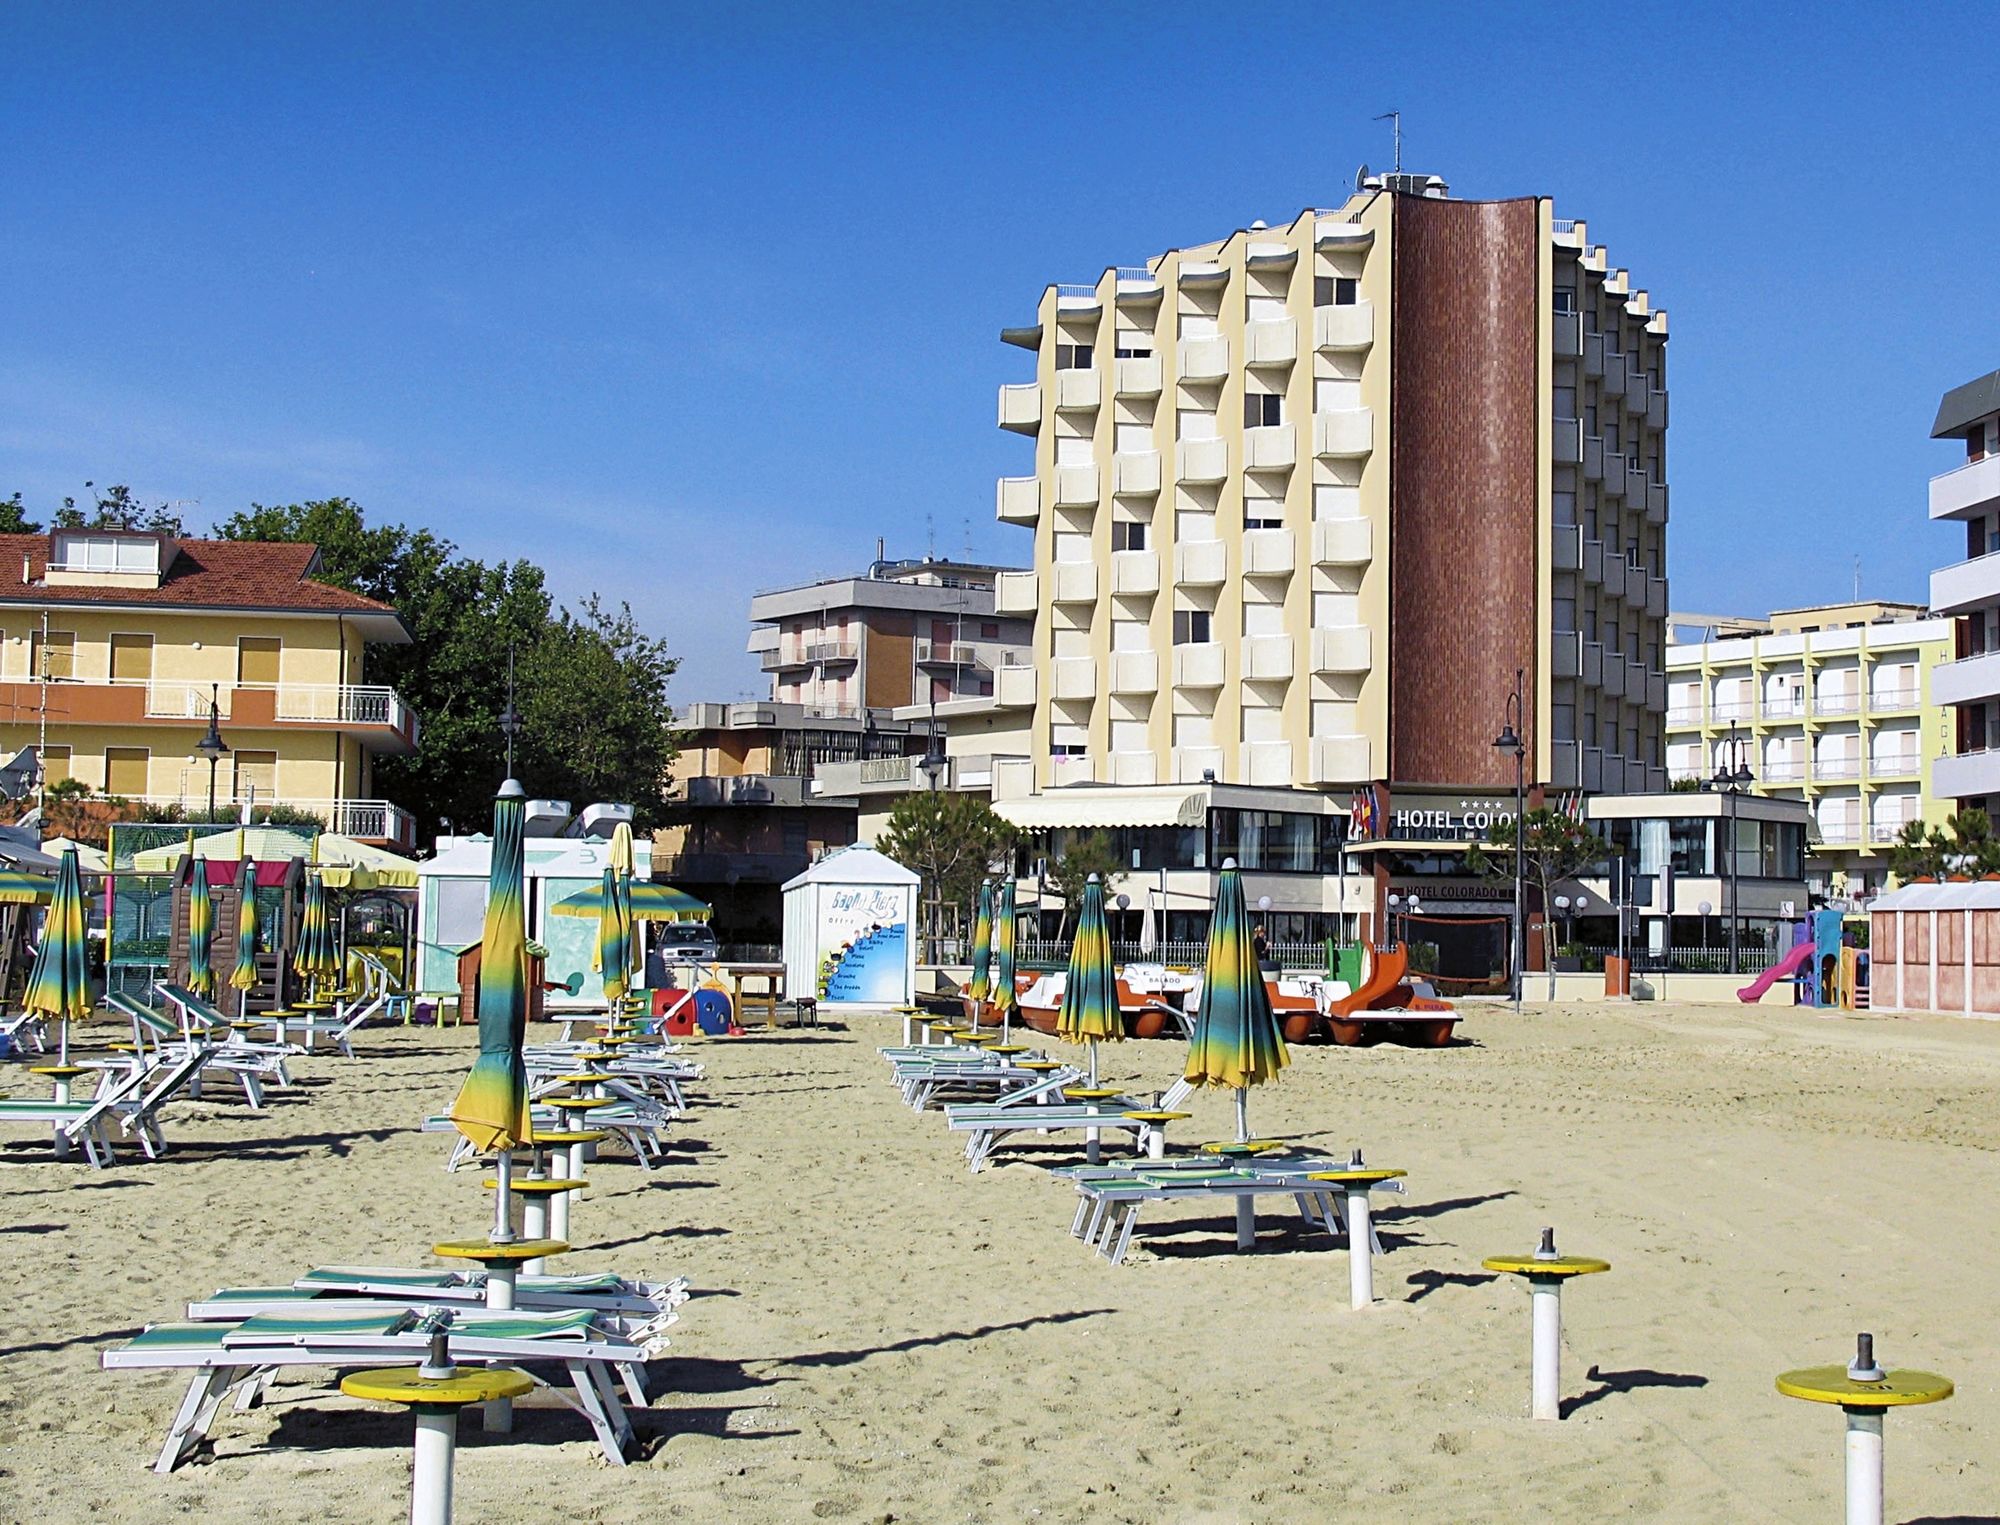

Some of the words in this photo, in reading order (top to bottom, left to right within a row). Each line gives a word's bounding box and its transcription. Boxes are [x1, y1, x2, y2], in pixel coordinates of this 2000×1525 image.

[1396, 809, 1455, 829] HOTEL
[1463, 811, 1518, 831] COLO
[1406, 886, 1438, 897] HOTEL
[1441, 886, 1497, 898] COLORADO
